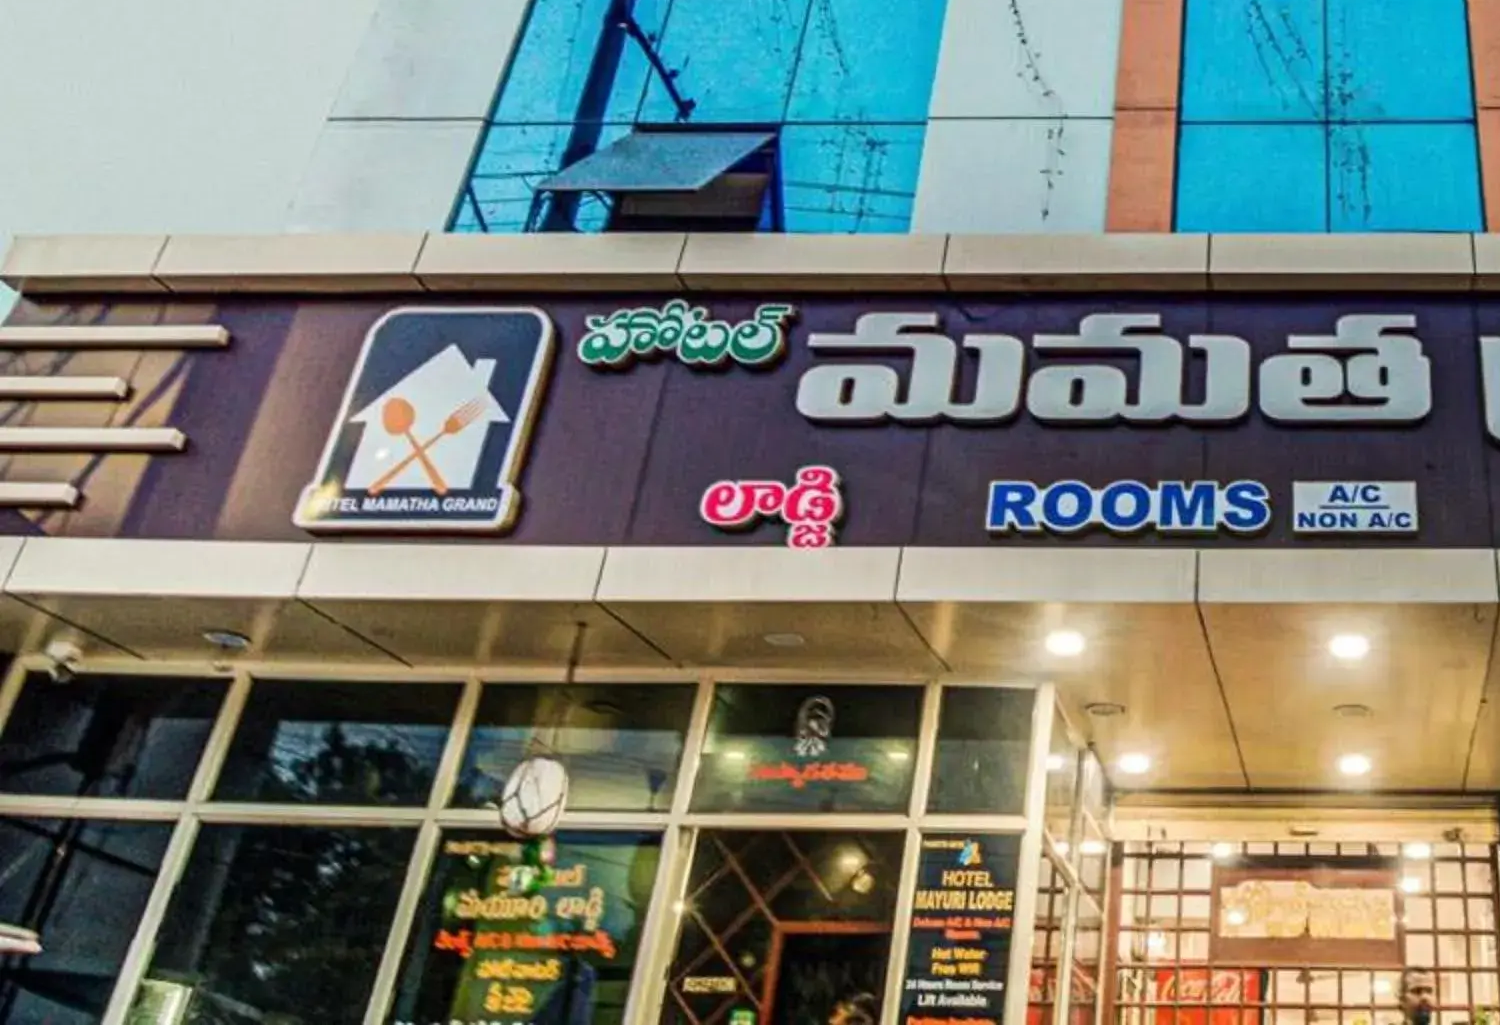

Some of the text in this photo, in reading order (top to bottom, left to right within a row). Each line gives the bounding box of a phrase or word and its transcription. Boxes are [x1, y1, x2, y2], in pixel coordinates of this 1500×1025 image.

[578, 299, 793, 364] హోటల్
[796, 312, 1433, 423] మమత
[361, 497, 440, 512] MAMATHA
[442, 497, 499, 512] GRAND
[1327, 484, 1381, 504] A/C
[986, 480, 1270, 532] ROOMS
[1297, 512, 1412, 528] NON A/C
[942, 870, 995, 887] HOTEL
[914, 889, 1014, 911] MAYURI LODGE
